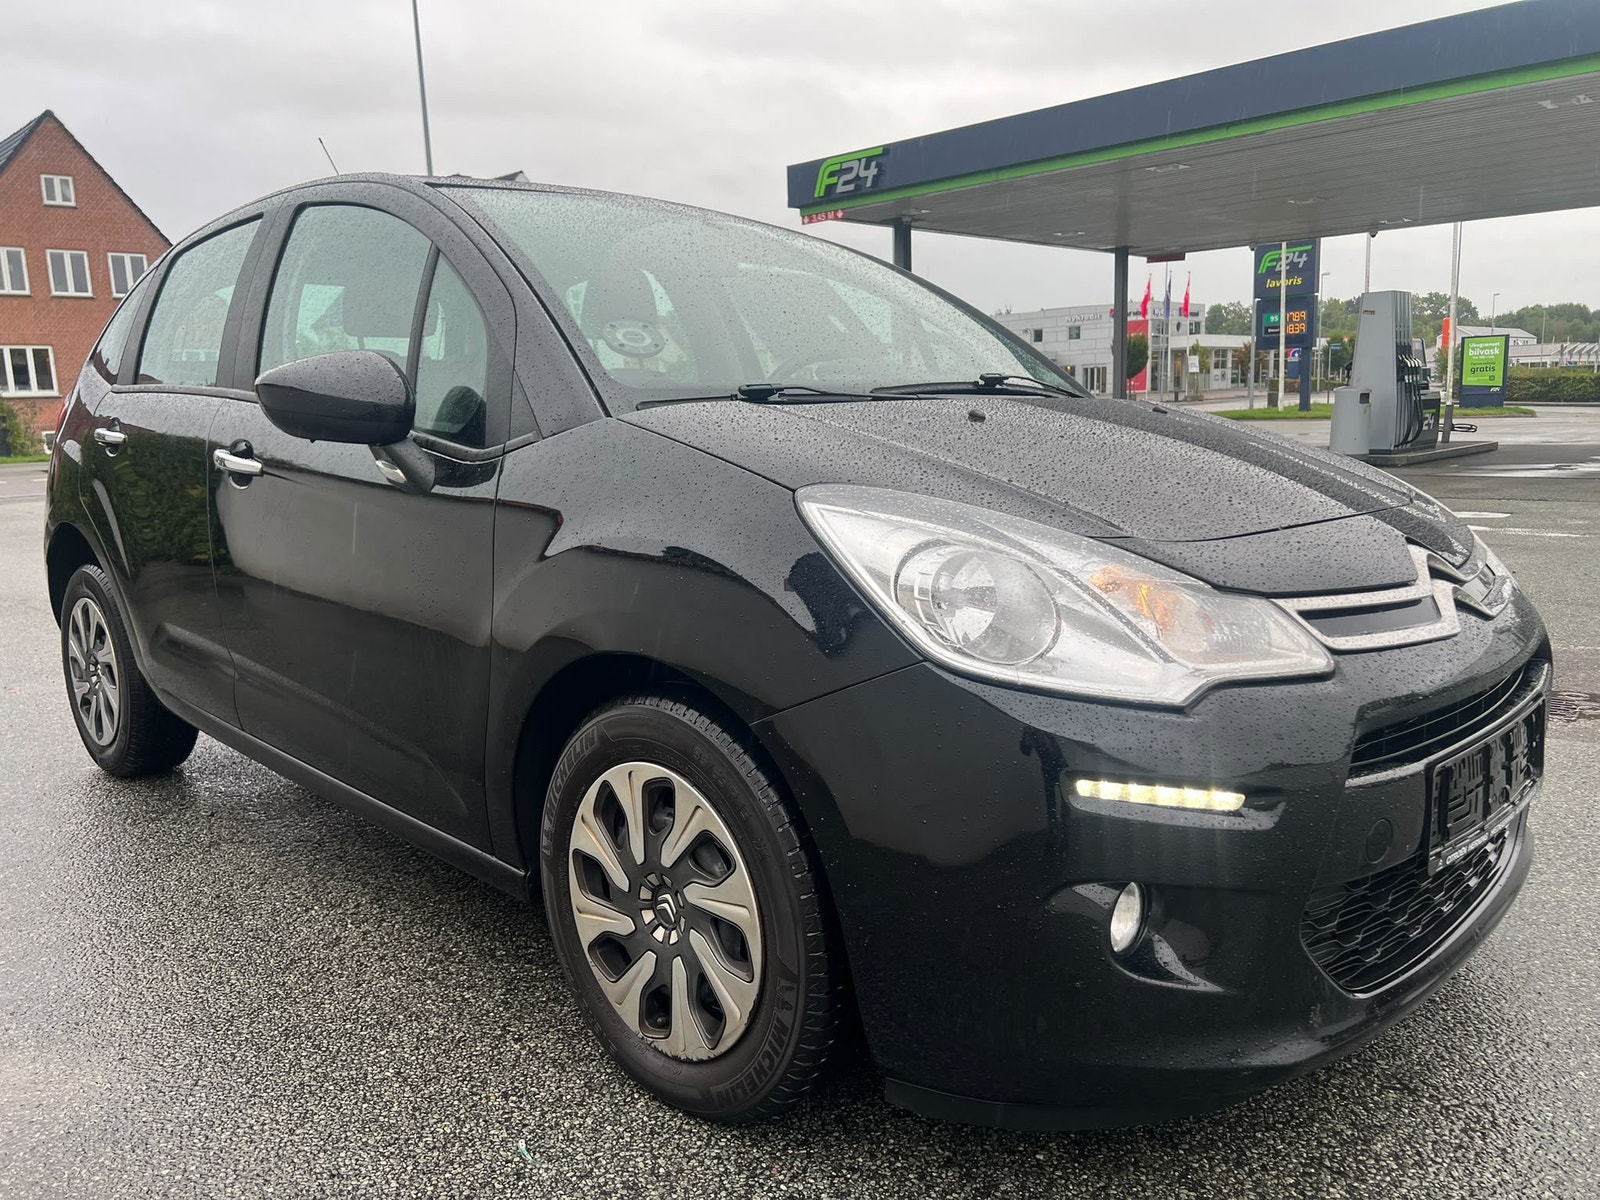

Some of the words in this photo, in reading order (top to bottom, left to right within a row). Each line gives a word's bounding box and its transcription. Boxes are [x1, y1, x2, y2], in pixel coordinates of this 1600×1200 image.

[814, 147, 884, 197] F24
[1258, 245, 1312, 274] F24
[1469, 347, 1500, 356] bilvask
[1471, 365, 1496, 374] gratis
[545, 724, 598, 818] MICHELIN
[714, 1015, 791, 1107] MICHELIN
